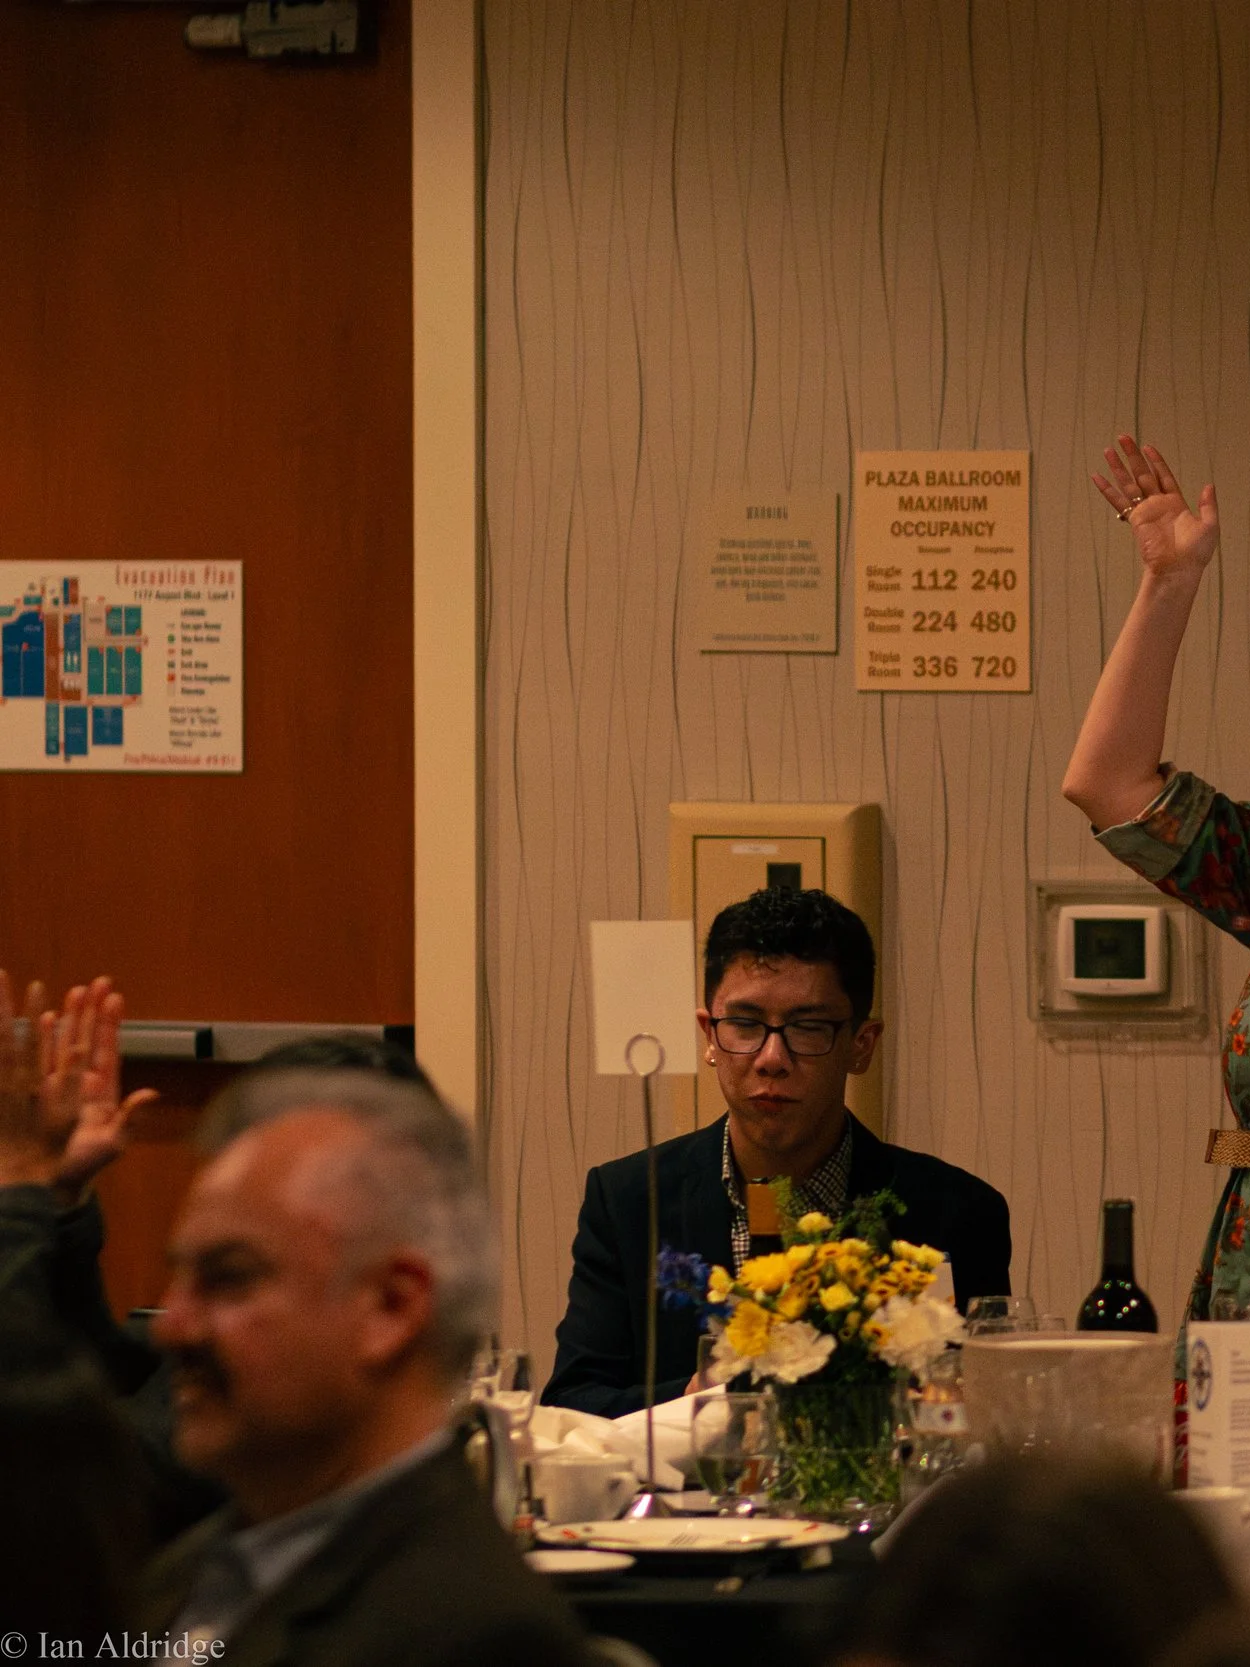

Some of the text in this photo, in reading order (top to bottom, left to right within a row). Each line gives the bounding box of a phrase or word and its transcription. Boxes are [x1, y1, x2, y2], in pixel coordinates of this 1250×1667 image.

[865, 470, 1021, 487] PLAZA BALLROOM
[898, 495, 988, 512] MAXIMUM
[890, 520, 995, 537] OCCUPANCY
[866, 565, 901, 579] Single
[912, 569, 1017, 591] 112 240
[864, 607, 904, 618] Double
[912, 611, 1017, 632] 224 480
[869, 651, 901, 663] Triple
[867, 666, 901, 677] Room
[913, 656, 1017, 678] 336 720
